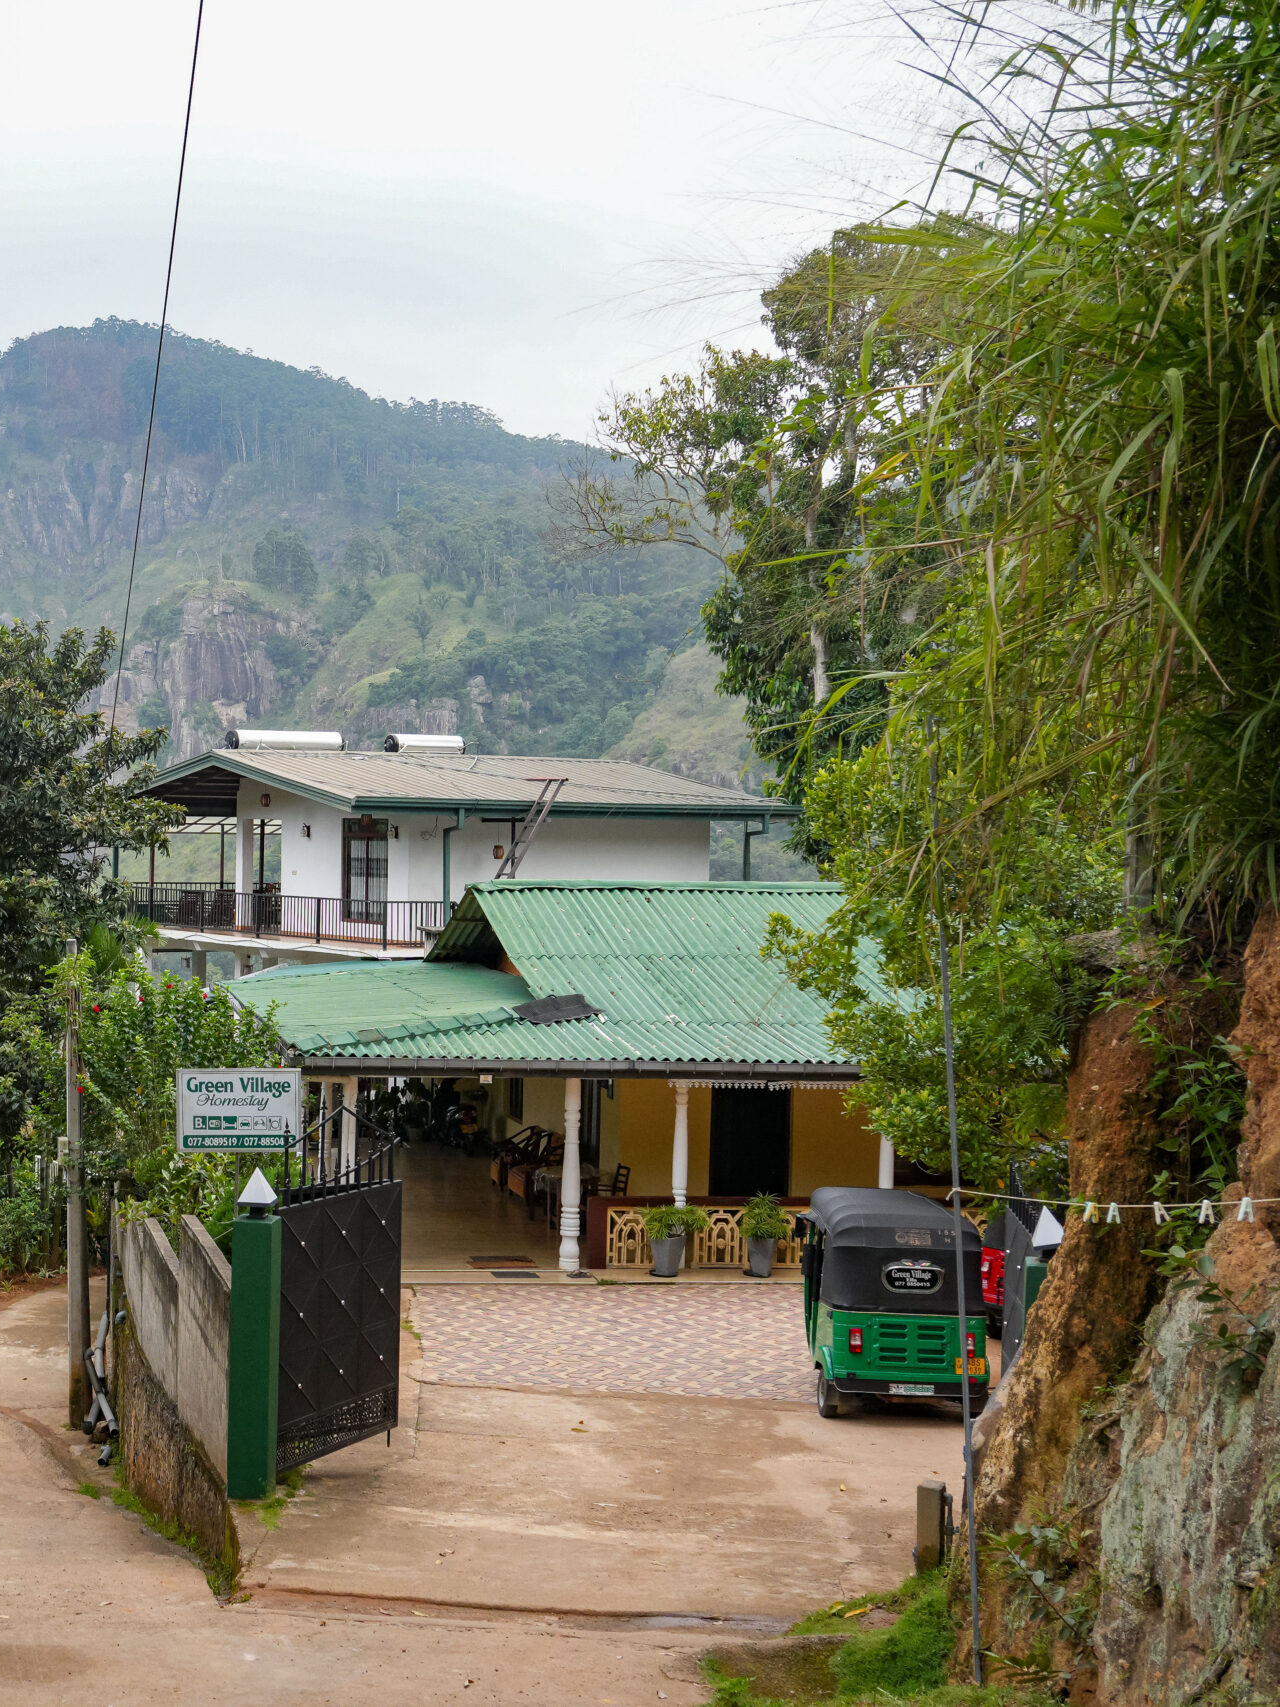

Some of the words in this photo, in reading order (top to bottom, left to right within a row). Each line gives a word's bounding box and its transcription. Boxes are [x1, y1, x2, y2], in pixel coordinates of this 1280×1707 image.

[186, 1076, 234, 1093] Green
[239, 1076, 291, 1098] Village
[196, 1093, 269, 1111] Homestay
[244, 1137, 294, 1147] 077-885045
[891, 1269, 910, 1278] Green
[911, 1270, 932, 1280] Village
